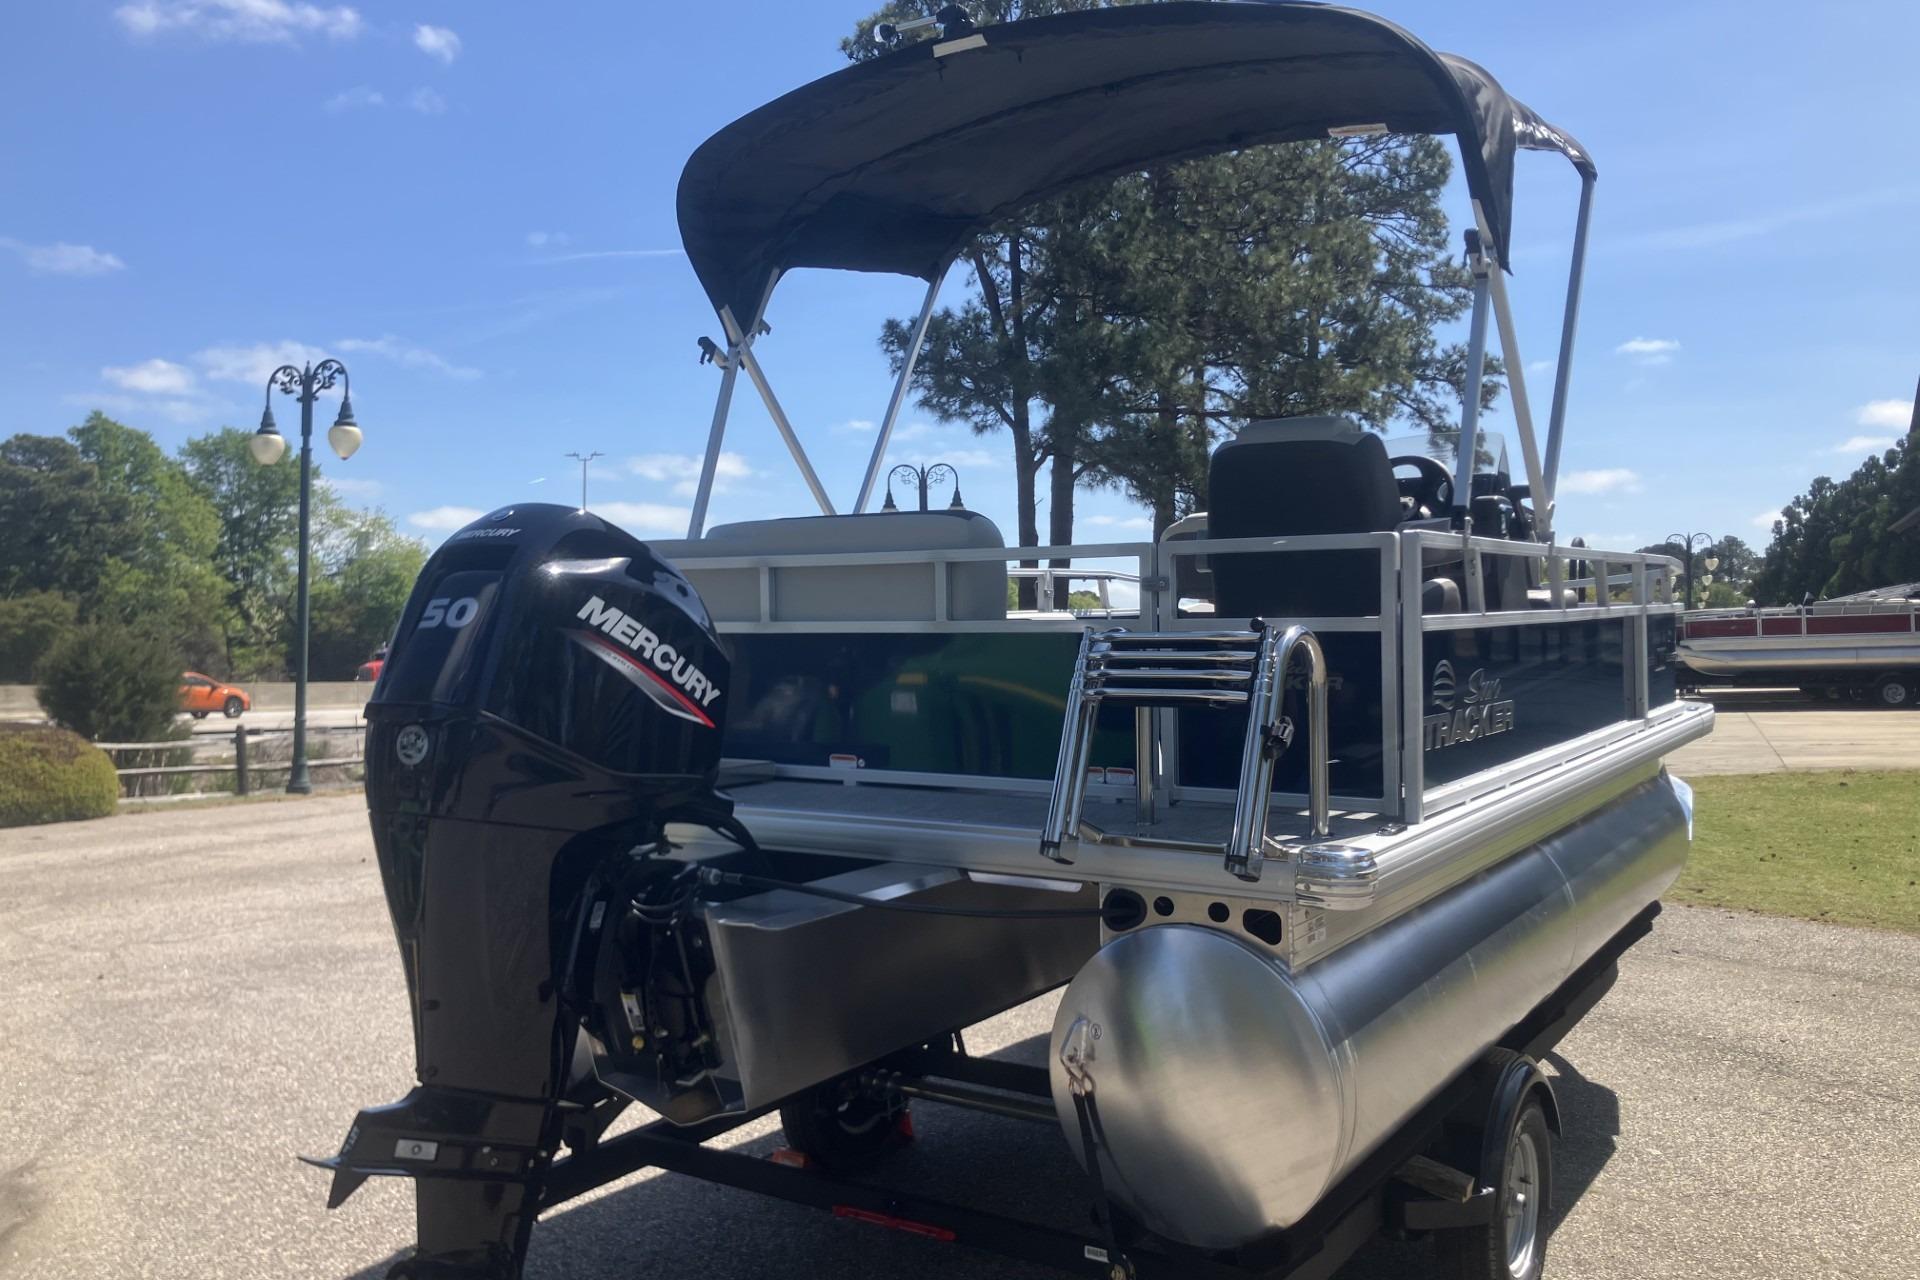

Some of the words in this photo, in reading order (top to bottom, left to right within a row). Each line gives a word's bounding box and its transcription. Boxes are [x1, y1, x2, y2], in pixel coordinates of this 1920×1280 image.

[418, 597, 479, 629] 50
[576, 595, 721, 707] MERCURY
[1424, 700, 1514, 751] TRACKER
